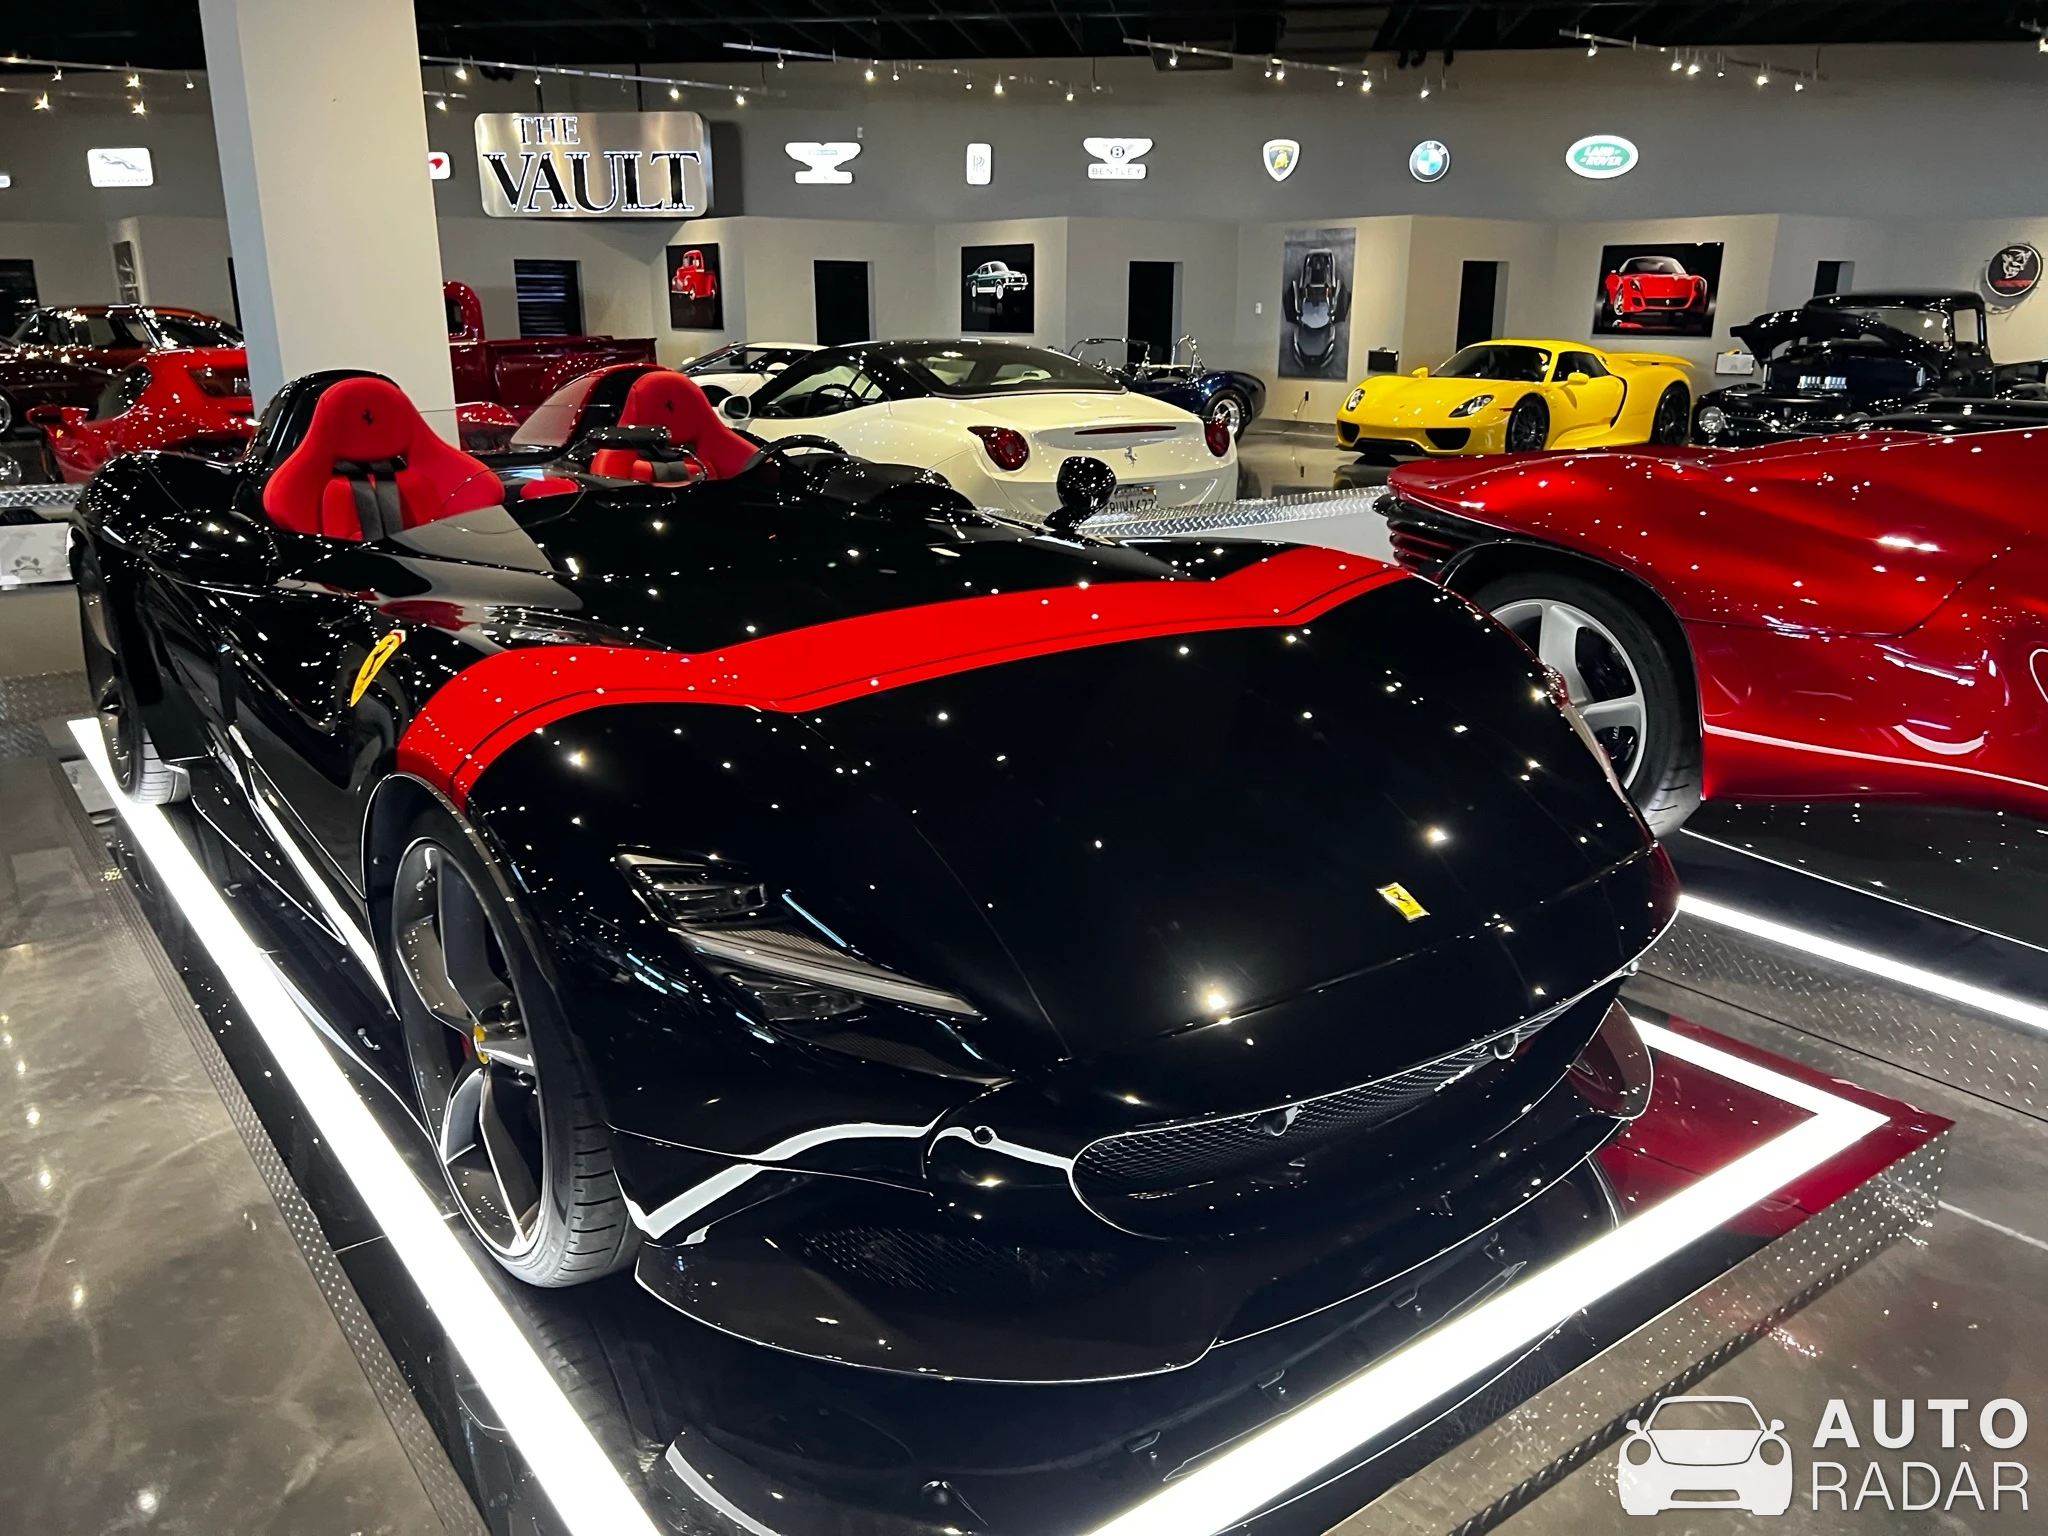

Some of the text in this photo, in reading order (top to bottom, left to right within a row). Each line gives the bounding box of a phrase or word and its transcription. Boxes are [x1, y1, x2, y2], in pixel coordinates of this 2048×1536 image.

[513, 116, 580, 145] THE
[482, 151, 702, 213] VAULT
[1091, 167, 1142, 176] BENTLEY
